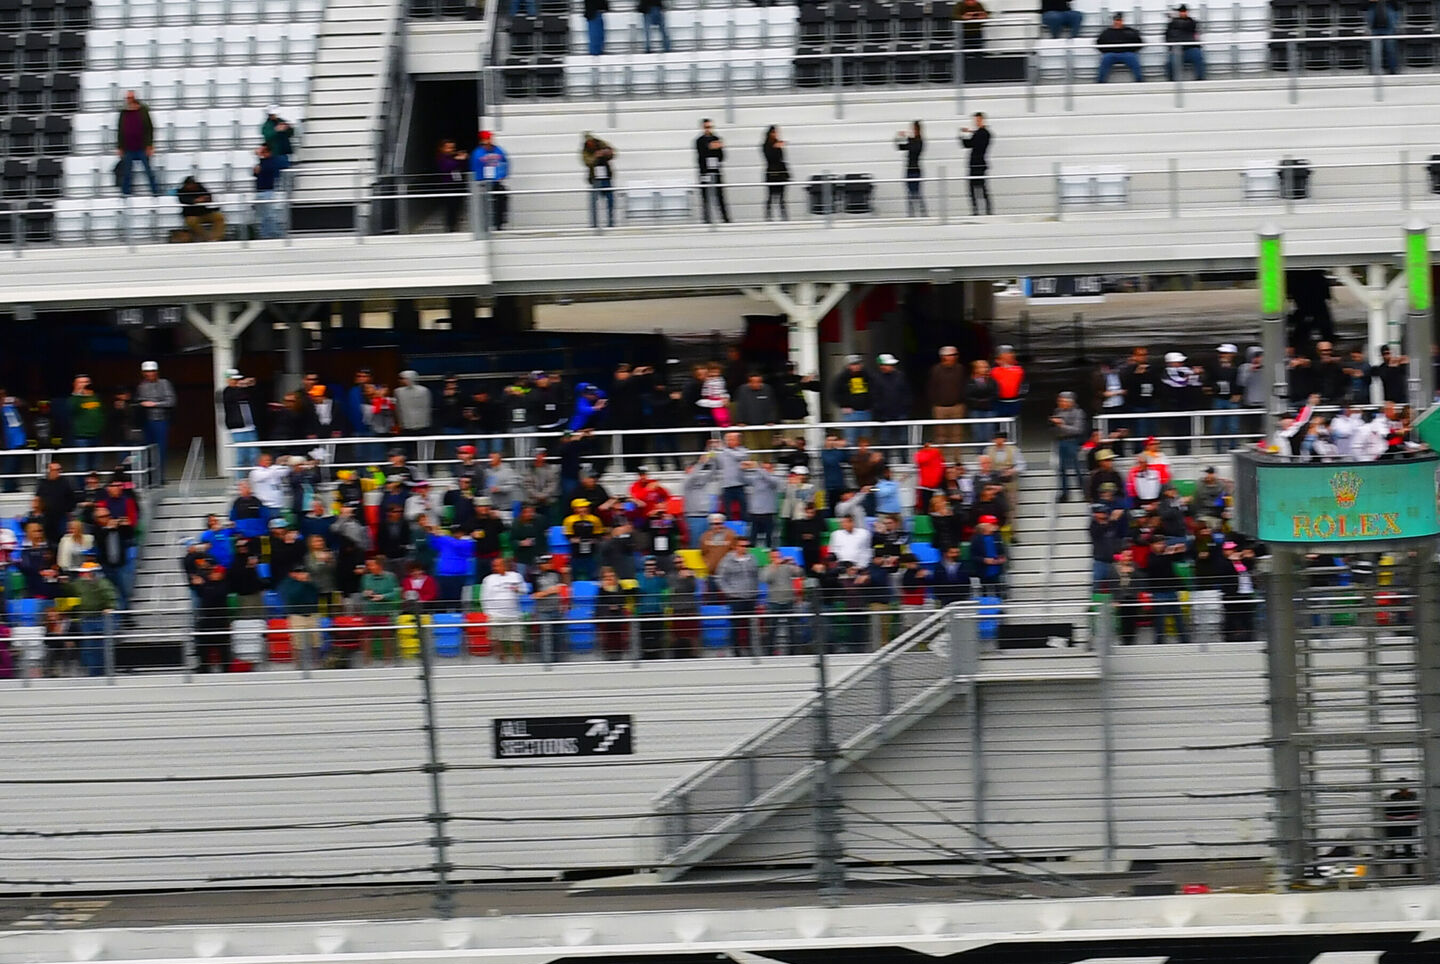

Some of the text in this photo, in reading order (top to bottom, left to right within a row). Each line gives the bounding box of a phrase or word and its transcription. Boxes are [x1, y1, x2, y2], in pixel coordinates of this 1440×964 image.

[1291, 512, 1402, 538] ROLEX
[499, 720, 532, 737] ALL
[499, 738, 579, 756] SECTIONS
